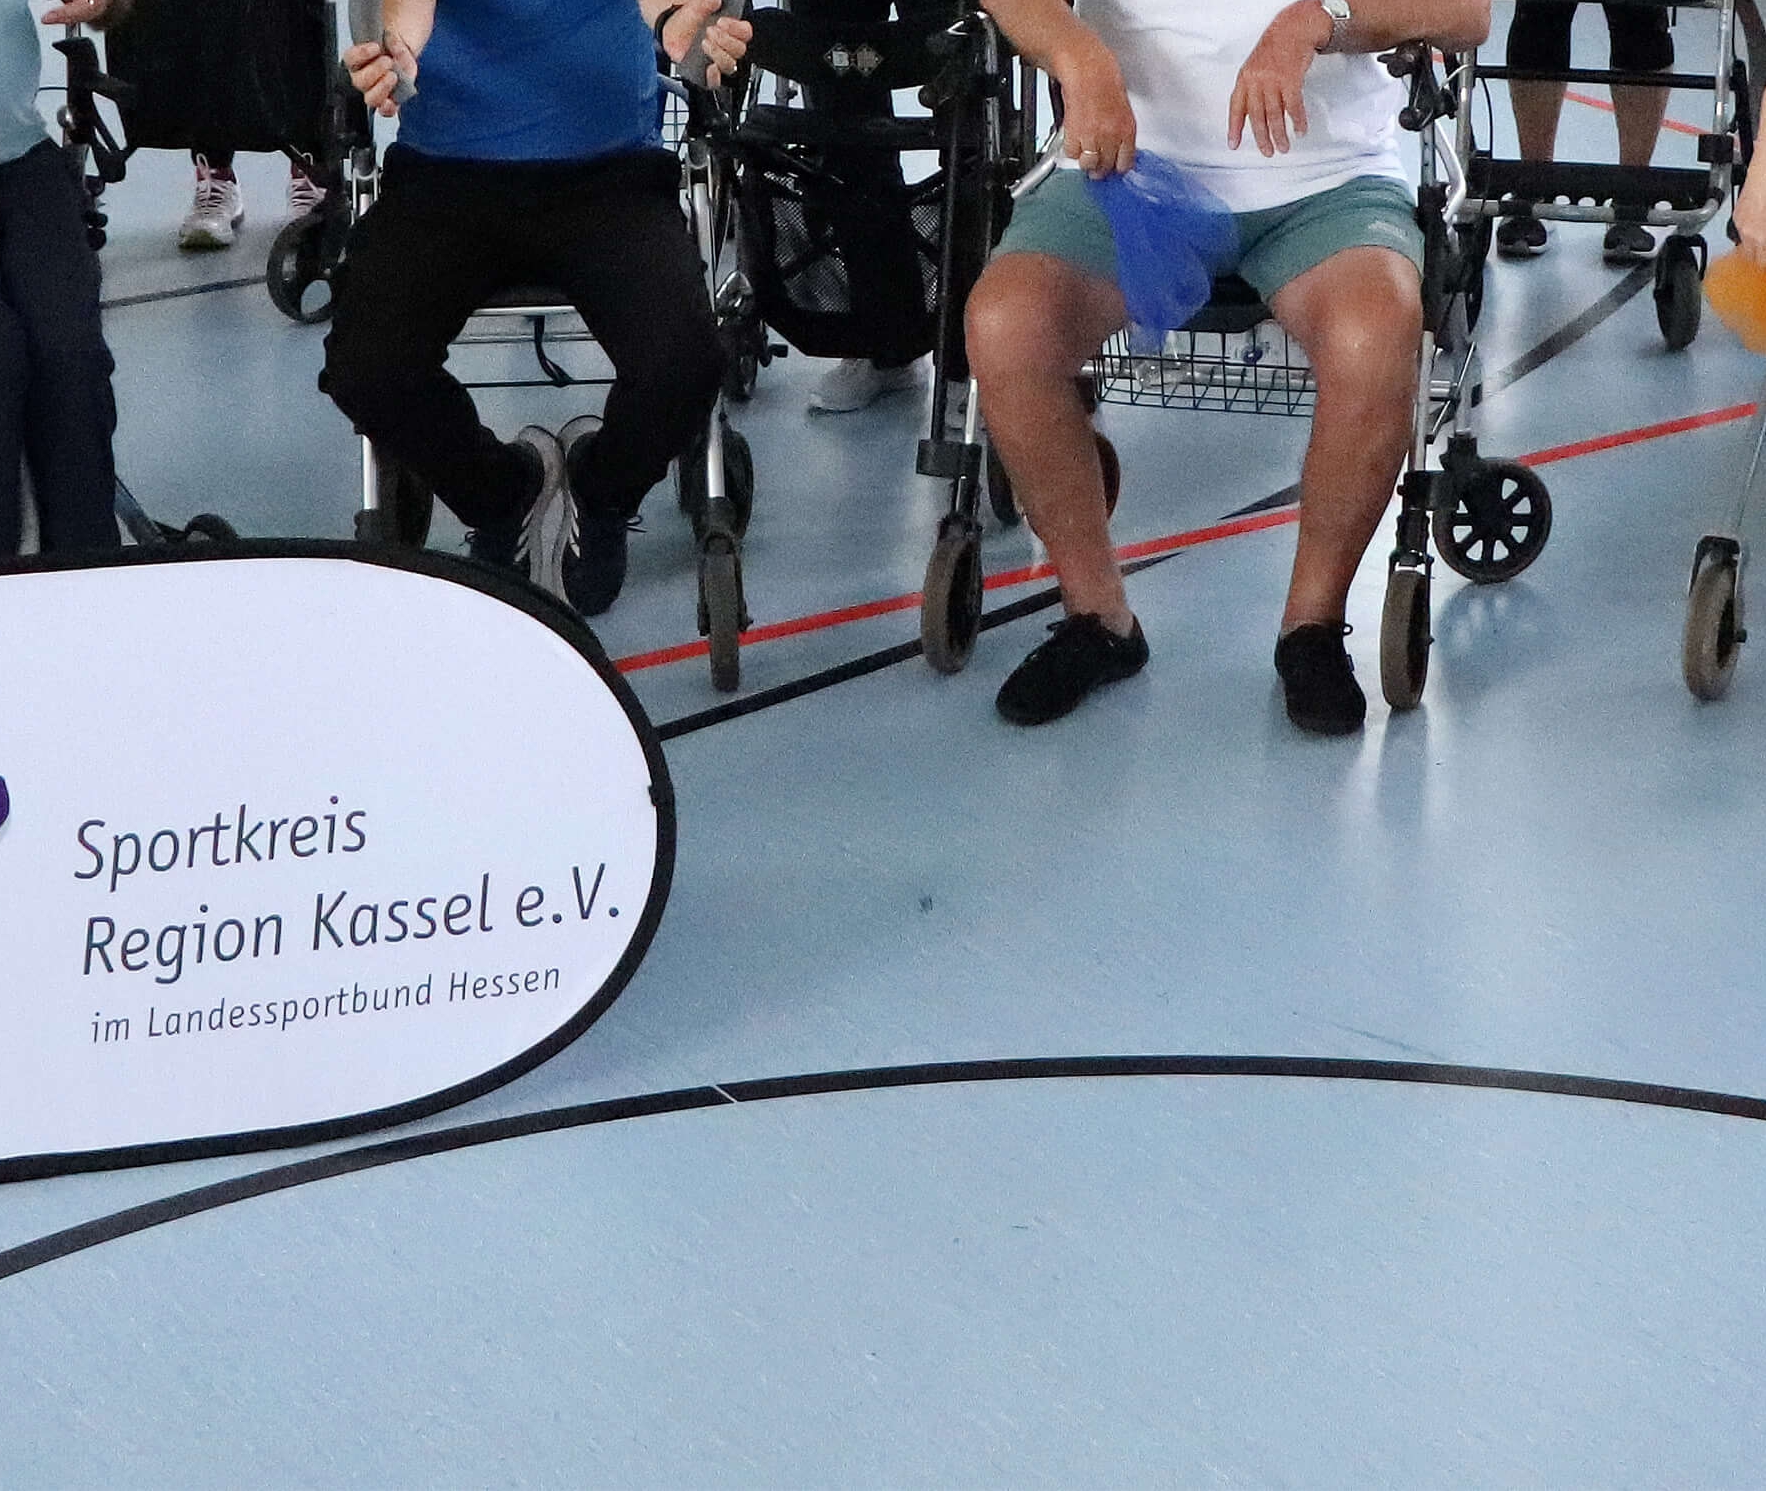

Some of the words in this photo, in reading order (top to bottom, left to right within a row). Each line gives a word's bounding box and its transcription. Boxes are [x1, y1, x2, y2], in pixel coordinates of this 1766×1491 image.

[74, 795, 367, 892] Sportkreis
[83, 904, 282, 985] Region
[312, 872, 494, 951] Kassel
[515, 862, 620, 928] e.V.
[90, 1012, 130, 1044] im
[148, 973, 432, 1037] Landessportbund
[449, 967, 560, 1002] Hessen
